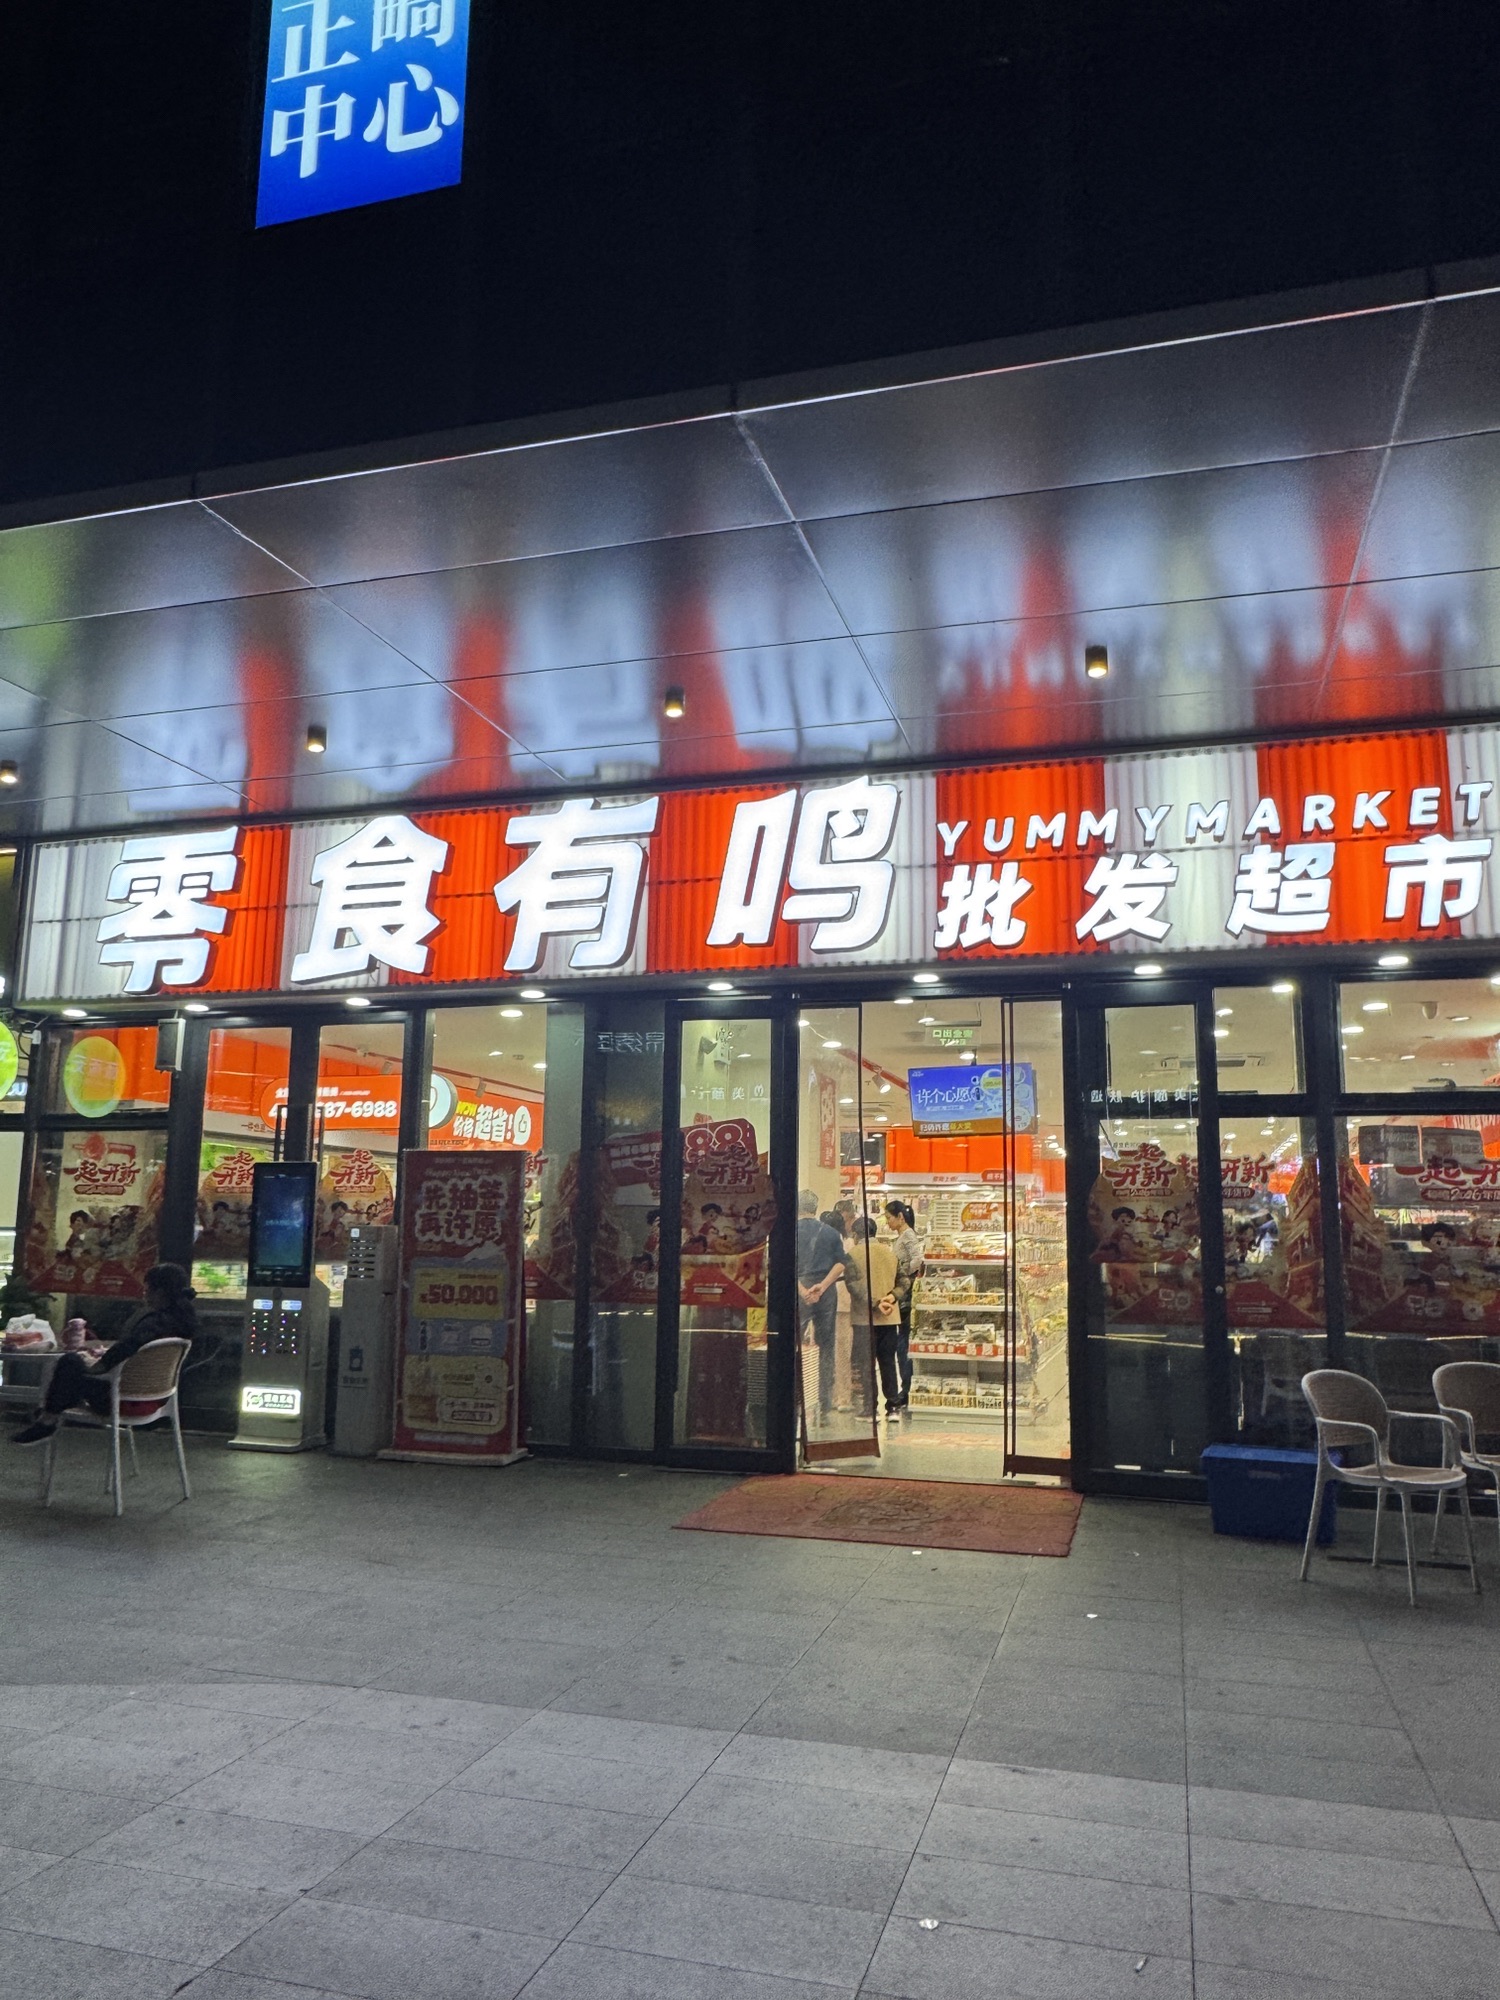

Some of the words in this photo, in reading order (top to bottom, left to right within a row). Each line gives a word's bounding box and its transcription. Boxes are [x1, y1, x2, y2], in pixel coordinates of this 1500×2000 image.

[270, 63, 459, 179] 中心
[97, 776, 899, 995] 零食有鸣
[935, 833, 1492, 950] 批发超市
[915, 1086, 972, 1107] 许个心愿
[341, 1149, 374, 1164] 一起
[1118, 1142, 1165, 1161] 一起
[64, 1159, 141, 1184] 一起开新
[329, 1163, 380, 1186] 开新
[1105, 1160, 1177, 1187] 开新
